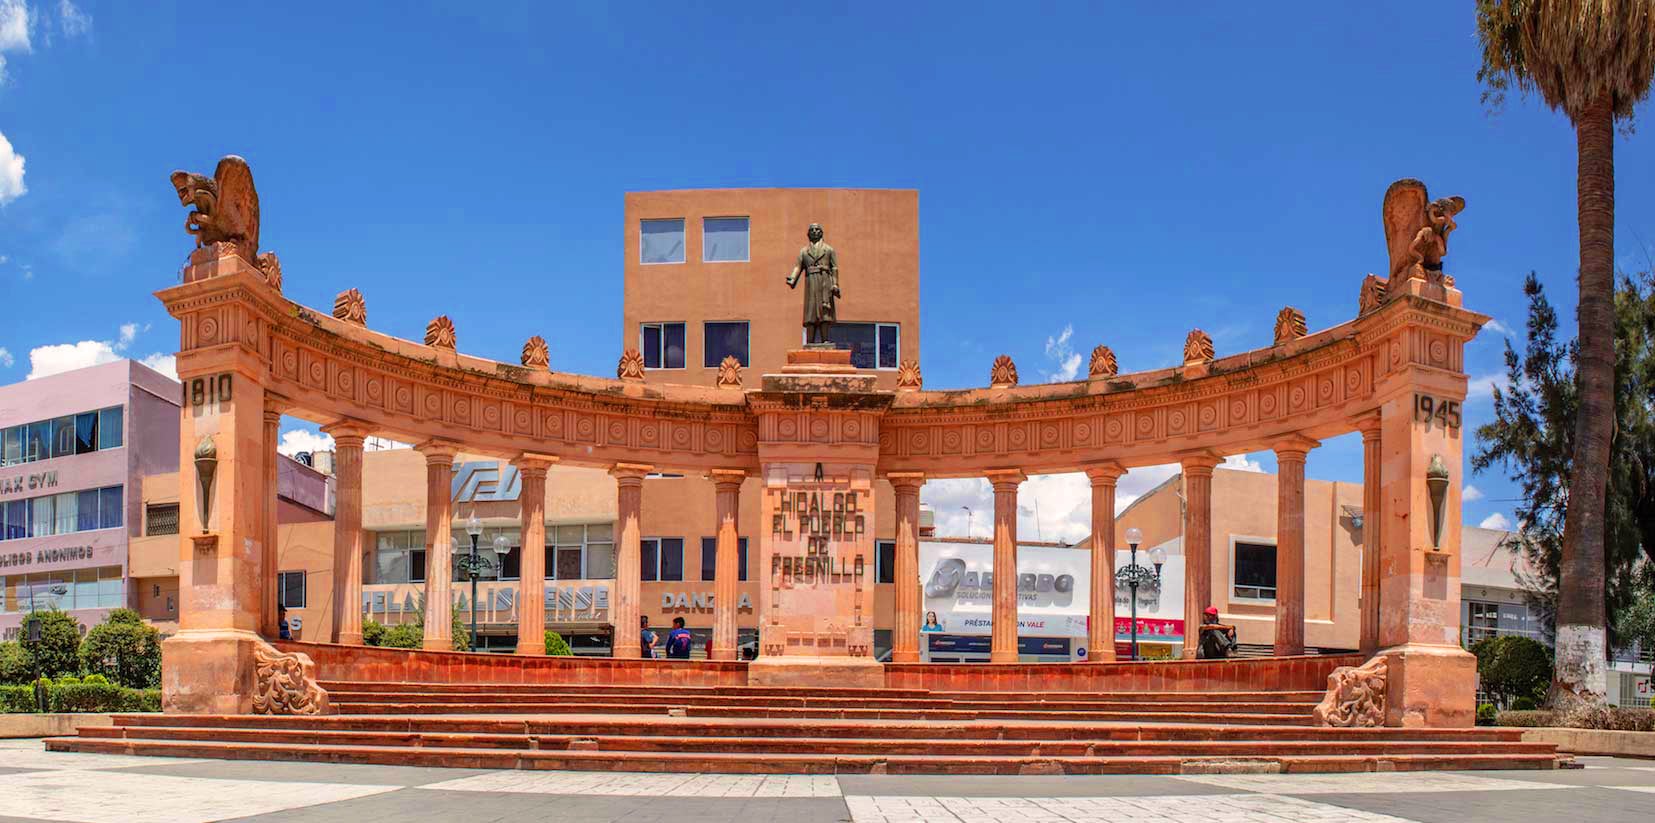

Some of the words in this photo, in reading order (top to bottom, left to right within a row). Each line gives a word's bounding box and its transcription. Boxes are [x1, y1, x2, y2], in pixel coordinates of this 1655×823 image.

[183, 373, 232, 408] 1810
[1414, 394, 1460, 429] 1945
[28, 470, 59, 490] GYM
[814, 462, 824, 481] A
[781, 491, 857, 513] HIDALGO
[772, 514, 793, 534] EL
[800, 514, 865, 534] PUEBLO
[807, 535, 829, 555] DE
[771, 556, 865, 576] FRESNILLO
[957, 590, 992, 600] SOLUCION
[964, 618, 993, 628] PRÉSTA
